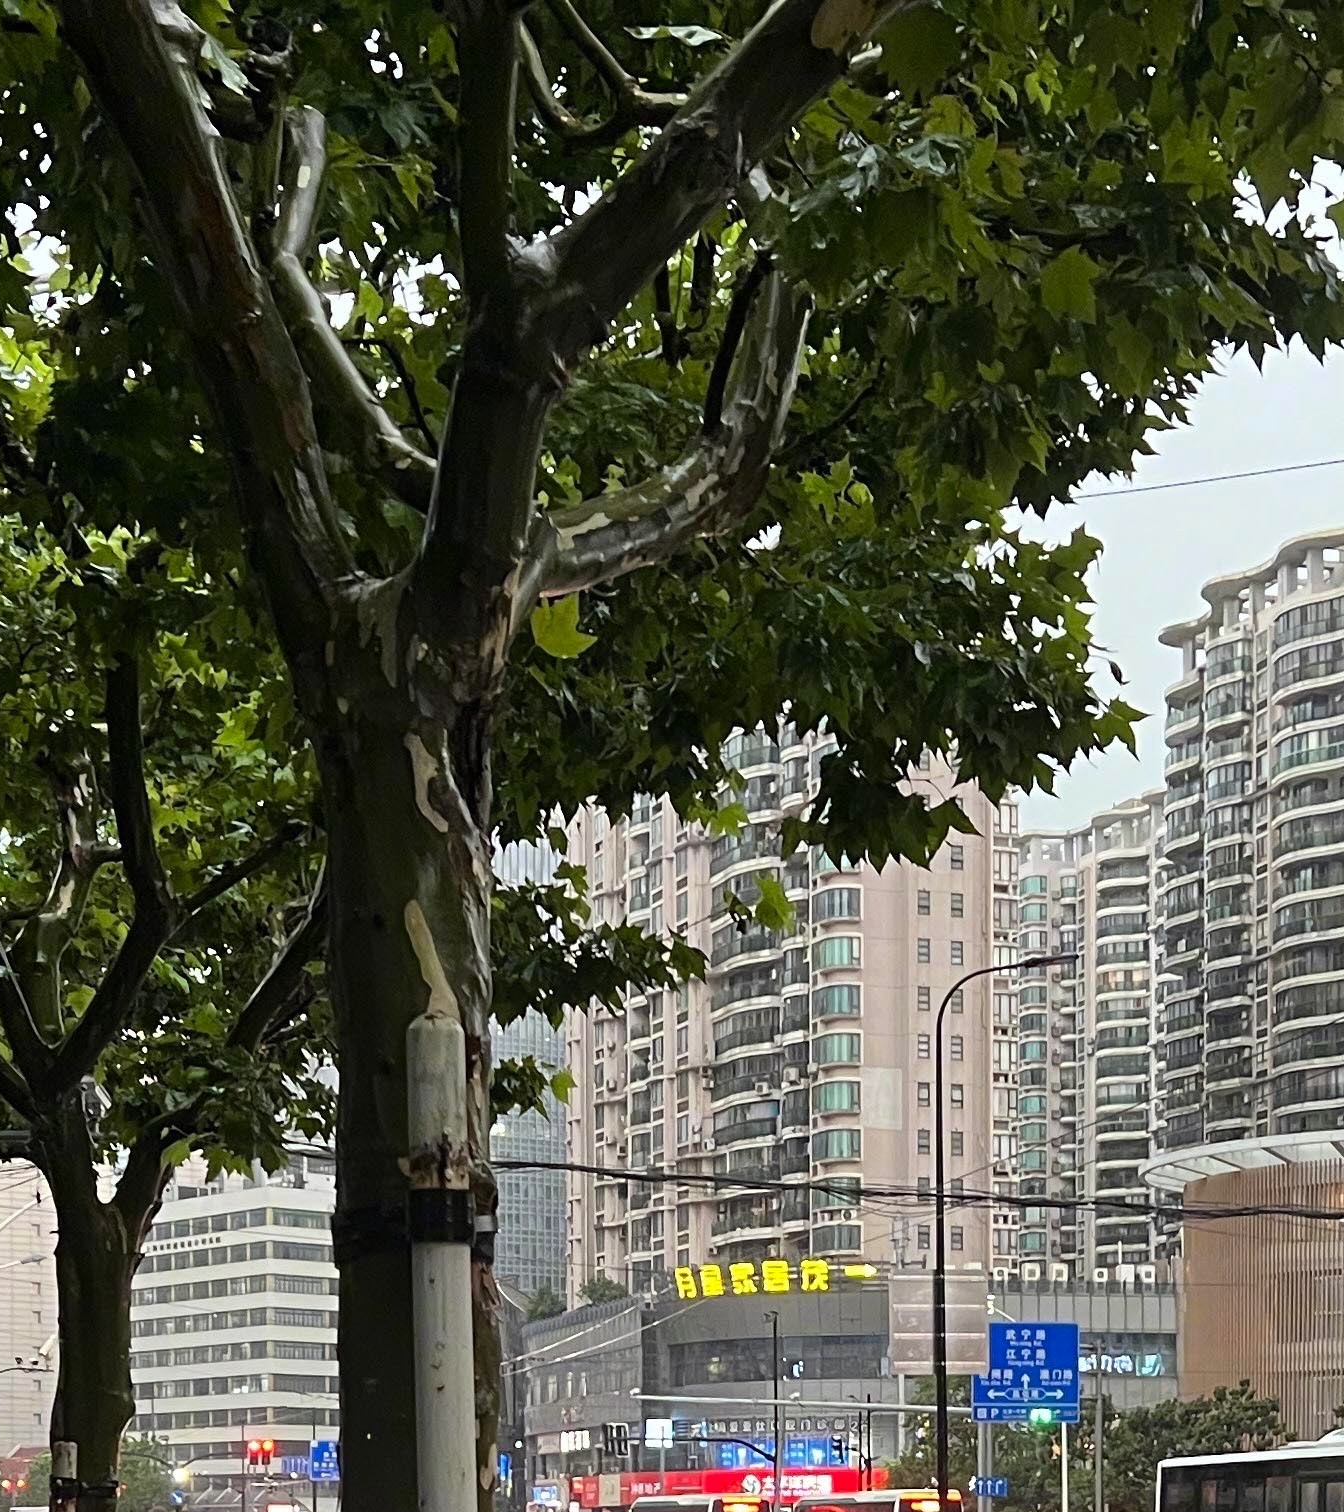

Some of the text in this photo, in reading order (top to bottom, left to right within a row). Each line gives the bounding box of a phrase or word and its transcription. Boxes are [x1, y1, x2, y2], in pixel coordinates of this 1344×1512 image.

[674, 1258, 830, 1299] 月星家居茂
[1006, 1328, 1046, 1340] 武宁路
